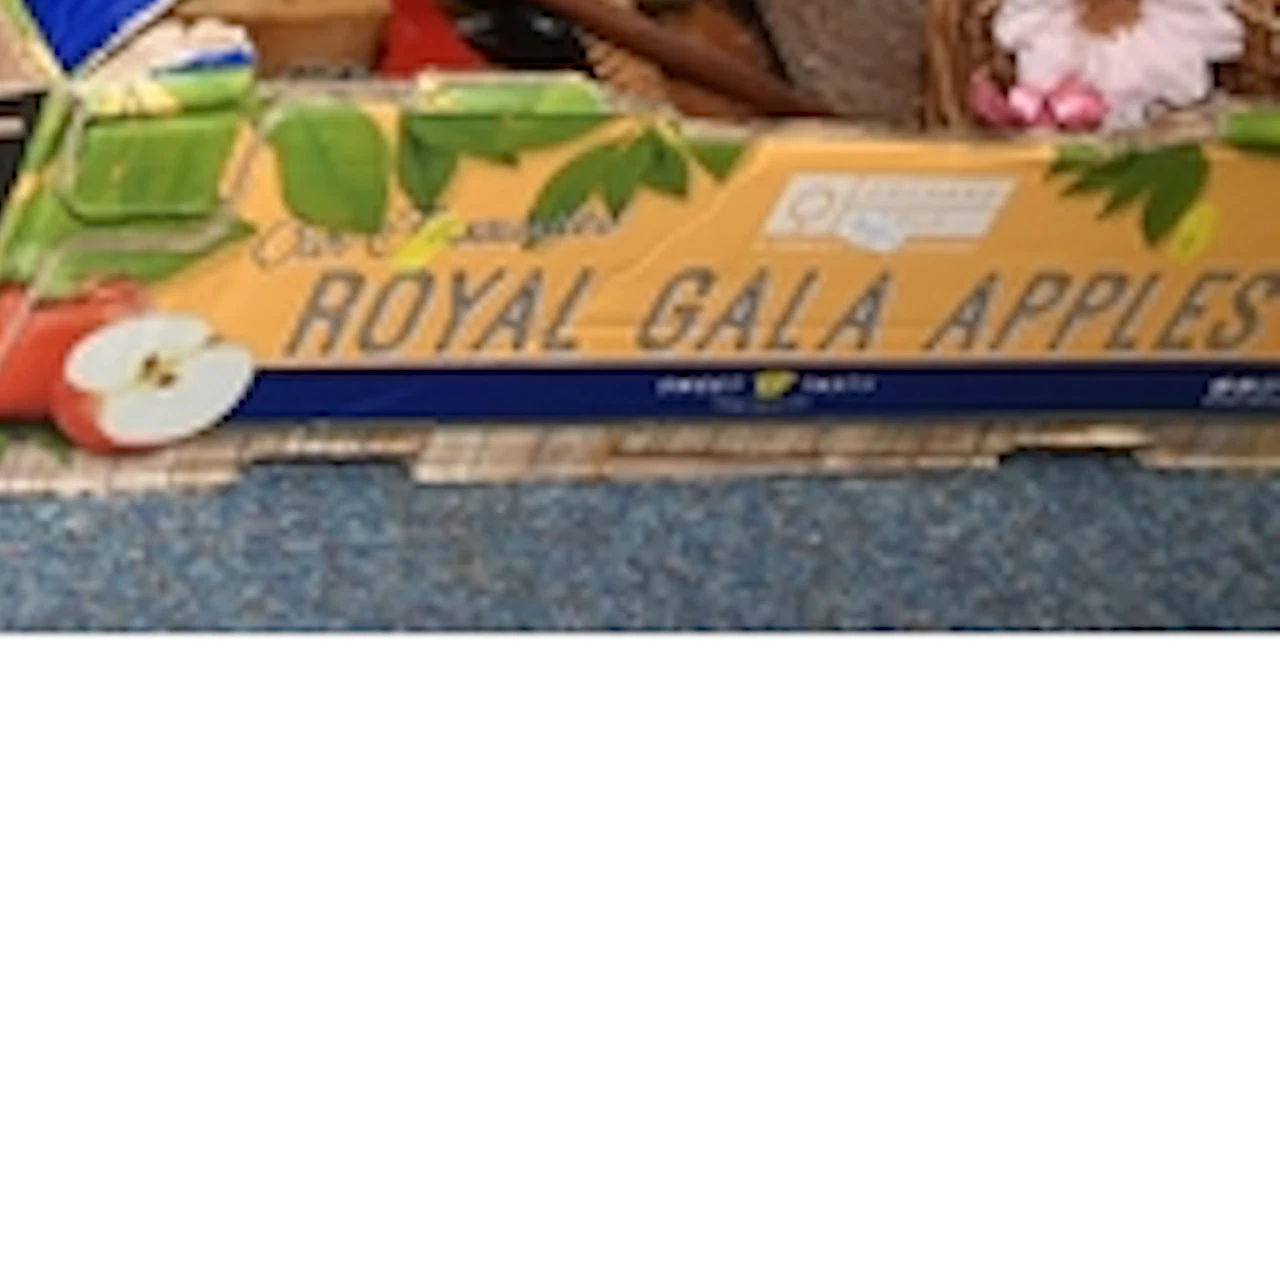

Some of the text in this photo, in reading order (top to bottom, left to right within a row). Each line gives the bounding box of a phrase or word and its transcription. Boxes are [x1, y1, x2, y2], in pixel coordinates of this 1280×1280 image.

[282, 266, 1280, 358] ROYAL GALA APPLES
